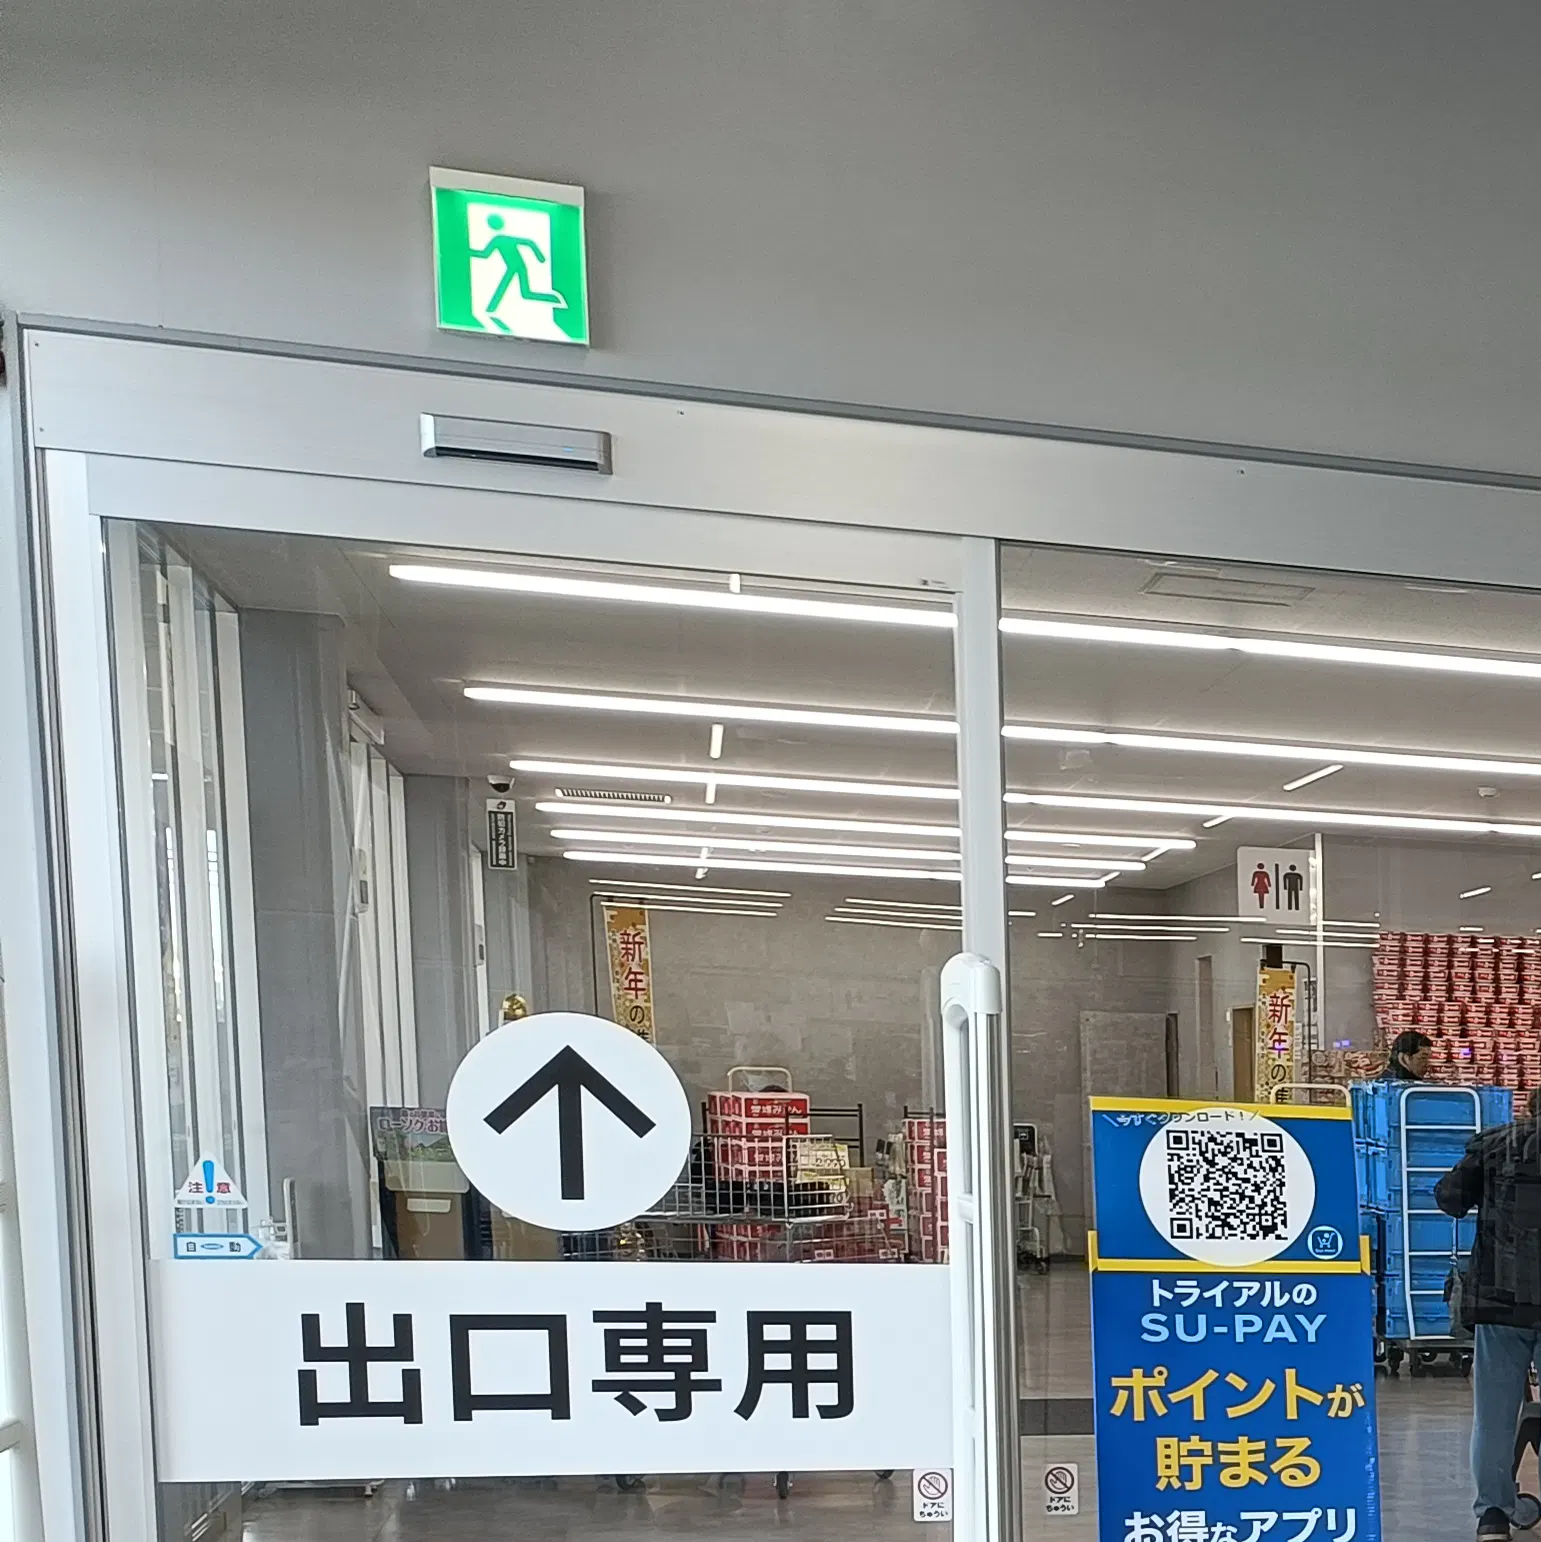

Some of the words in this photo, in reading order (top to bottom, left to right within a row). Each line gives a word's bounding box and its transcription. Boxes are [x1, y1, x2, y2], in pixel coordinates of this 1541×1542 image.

[1152, 1279, 1318, 1308] トライアルの
[1140, 1312, 1327, 1343] SU-PAY
[297, 1301, 855, 1426] 出口専用
[1109, 1365, 1366, 1422] ポイントが
[1155, 1435, 1322, 1492] 貯まる
